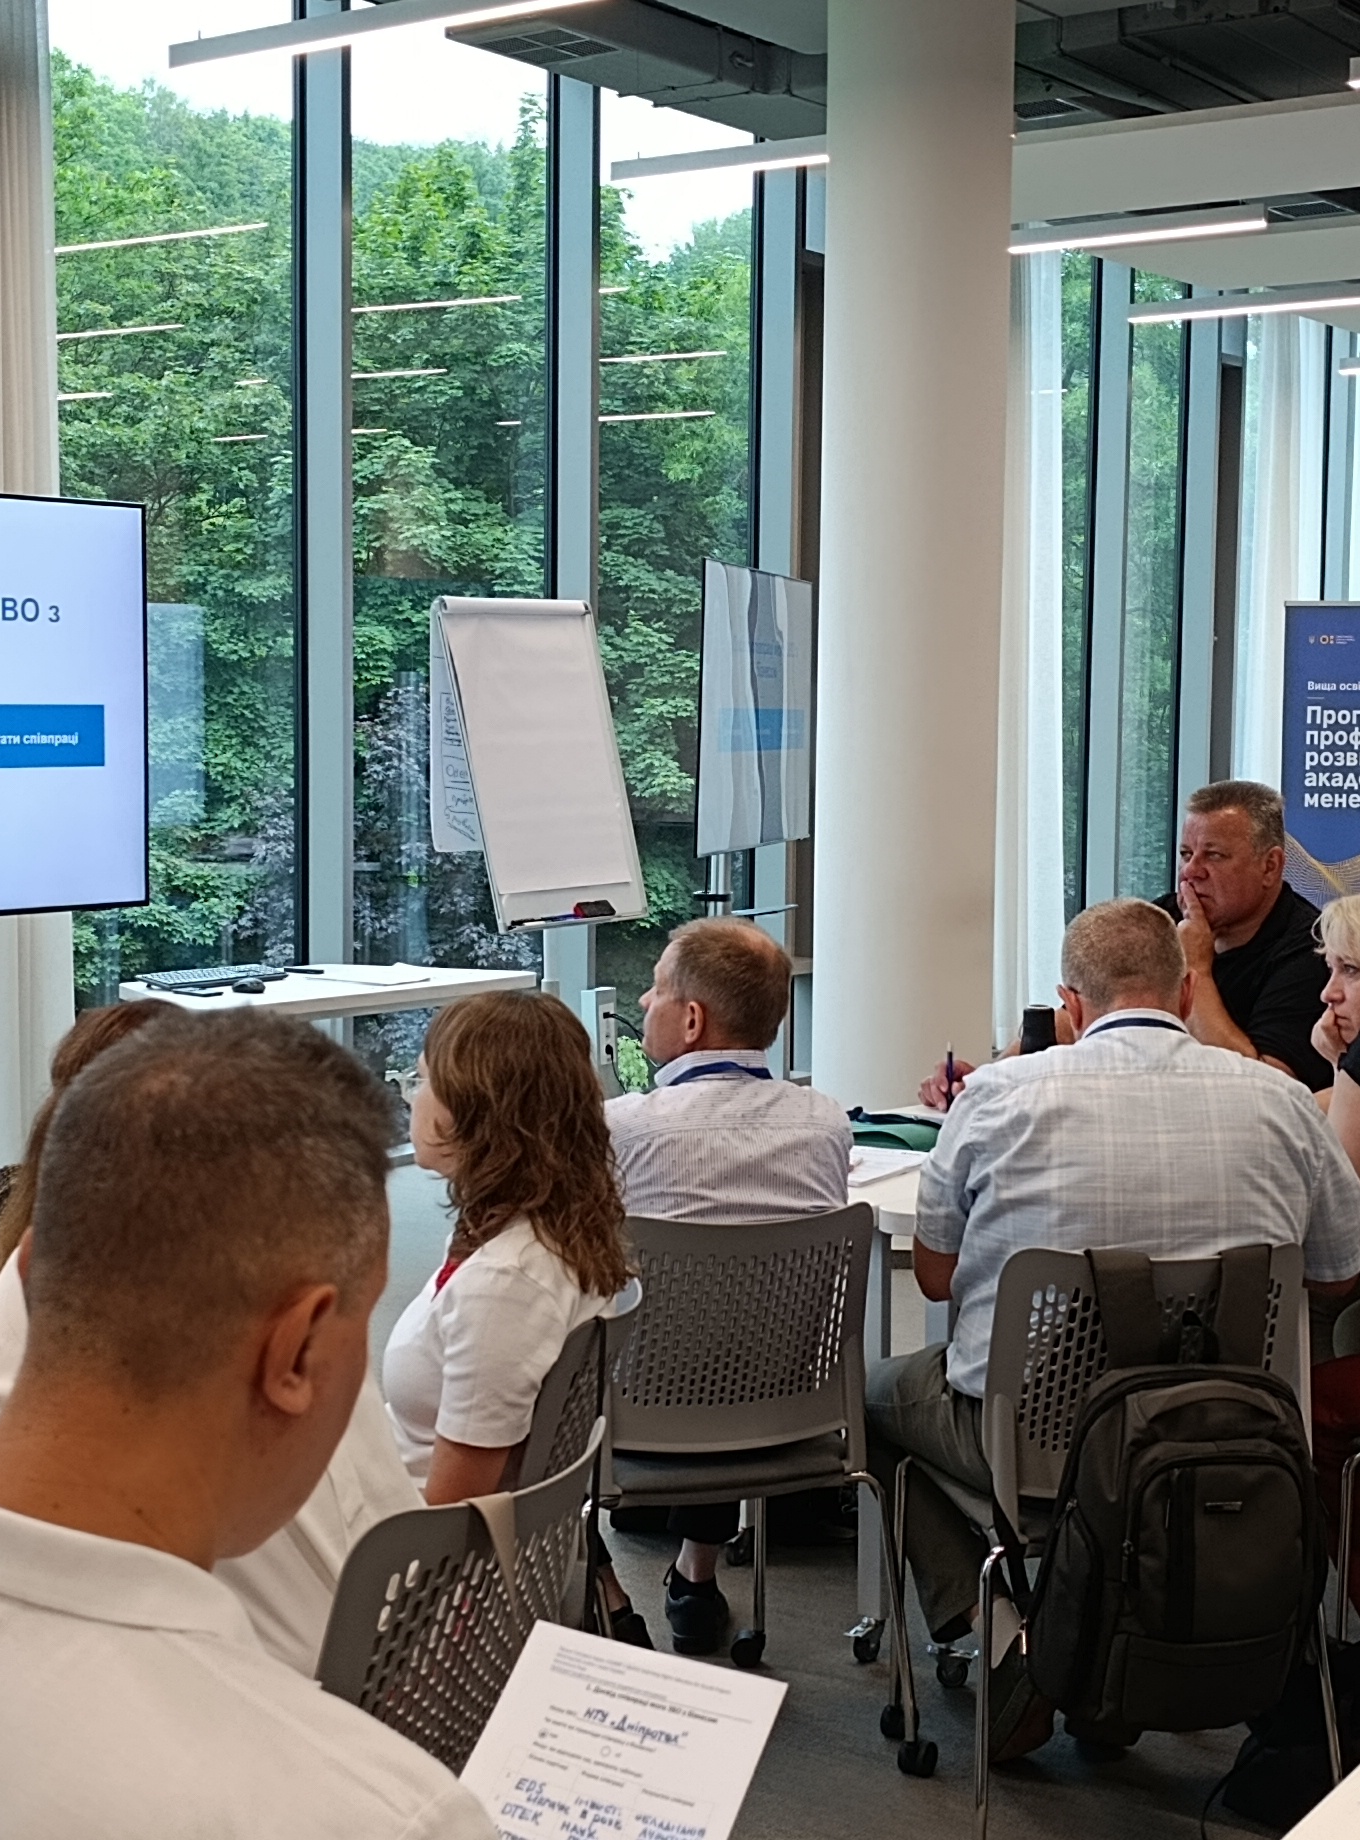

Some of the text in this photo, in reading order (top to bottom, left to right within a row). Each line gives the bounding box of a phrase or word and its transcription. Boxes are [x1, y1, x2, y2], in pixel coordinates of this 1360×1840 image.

[48, 604, 60, 623] з
[1307, 680, 1337, 692] Вища
[23, 731, 79, 746] співпраці
